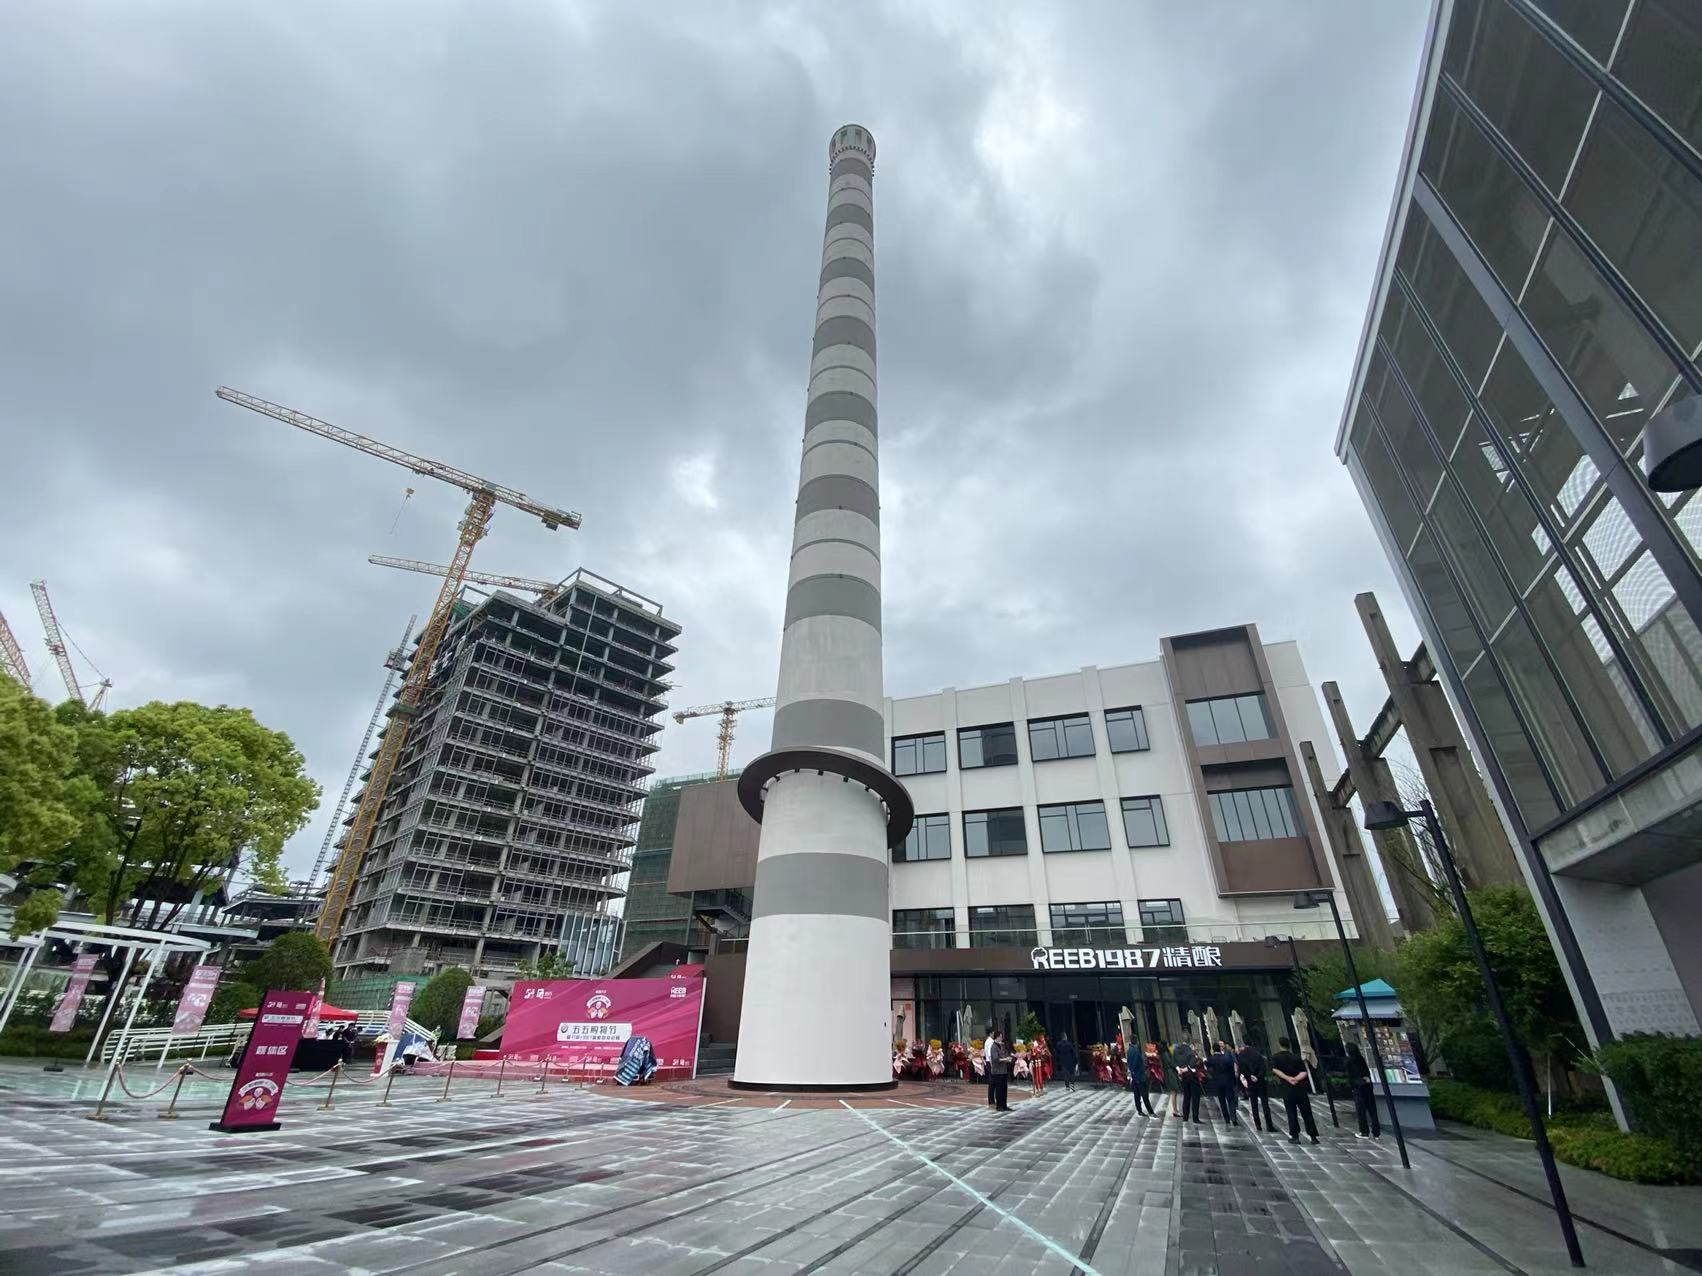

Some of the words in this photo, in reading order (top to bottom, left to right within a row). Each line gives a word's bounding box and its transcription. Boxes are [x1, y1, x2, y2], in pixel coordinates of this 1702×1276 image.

[573, 1025, 617, 1035] 五五购物节
